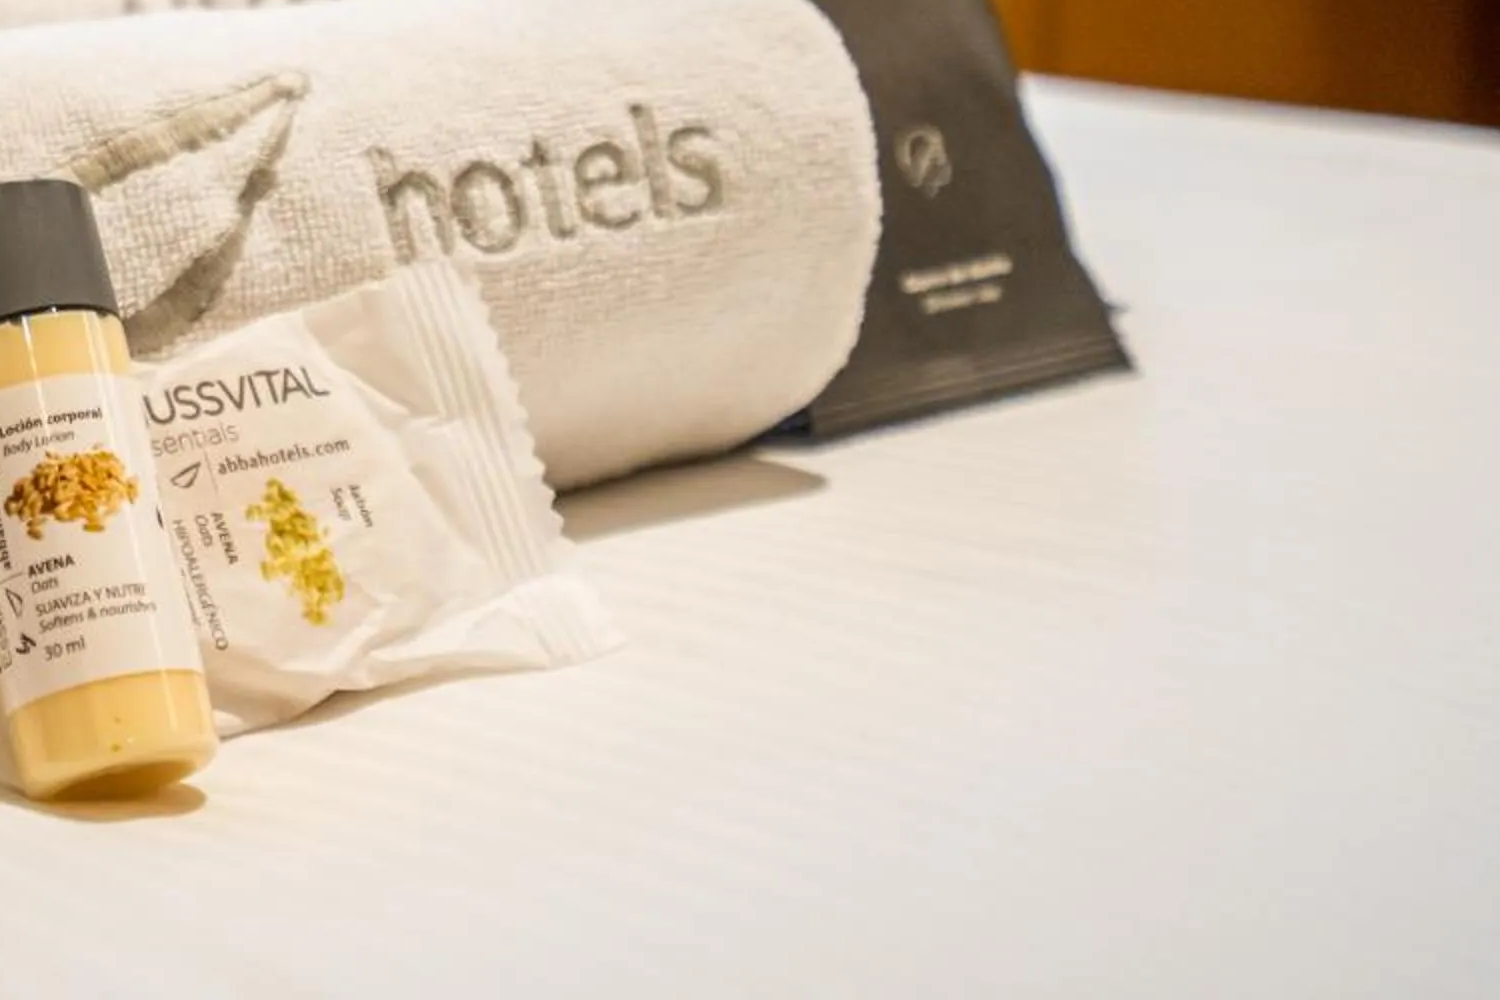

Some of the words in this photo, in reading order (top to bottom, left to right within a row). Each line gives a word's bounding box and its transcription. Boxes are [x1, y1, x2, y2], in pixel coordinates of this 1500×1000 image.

[368, 103, 724, 264] hotels
[142, 366, 331, 427] USSVITAL
[151, 421, 240, 458] sentials
[218, 438, 350, 475] abbahotels.com
[211, 511, 239, 565] AVENA
[28, 554, 75, 578] AVENA
[36, 590, 91, 617] SUAVIZA
[44, 642, 63, 661] 30
[66, 634, 86, 654] ml
